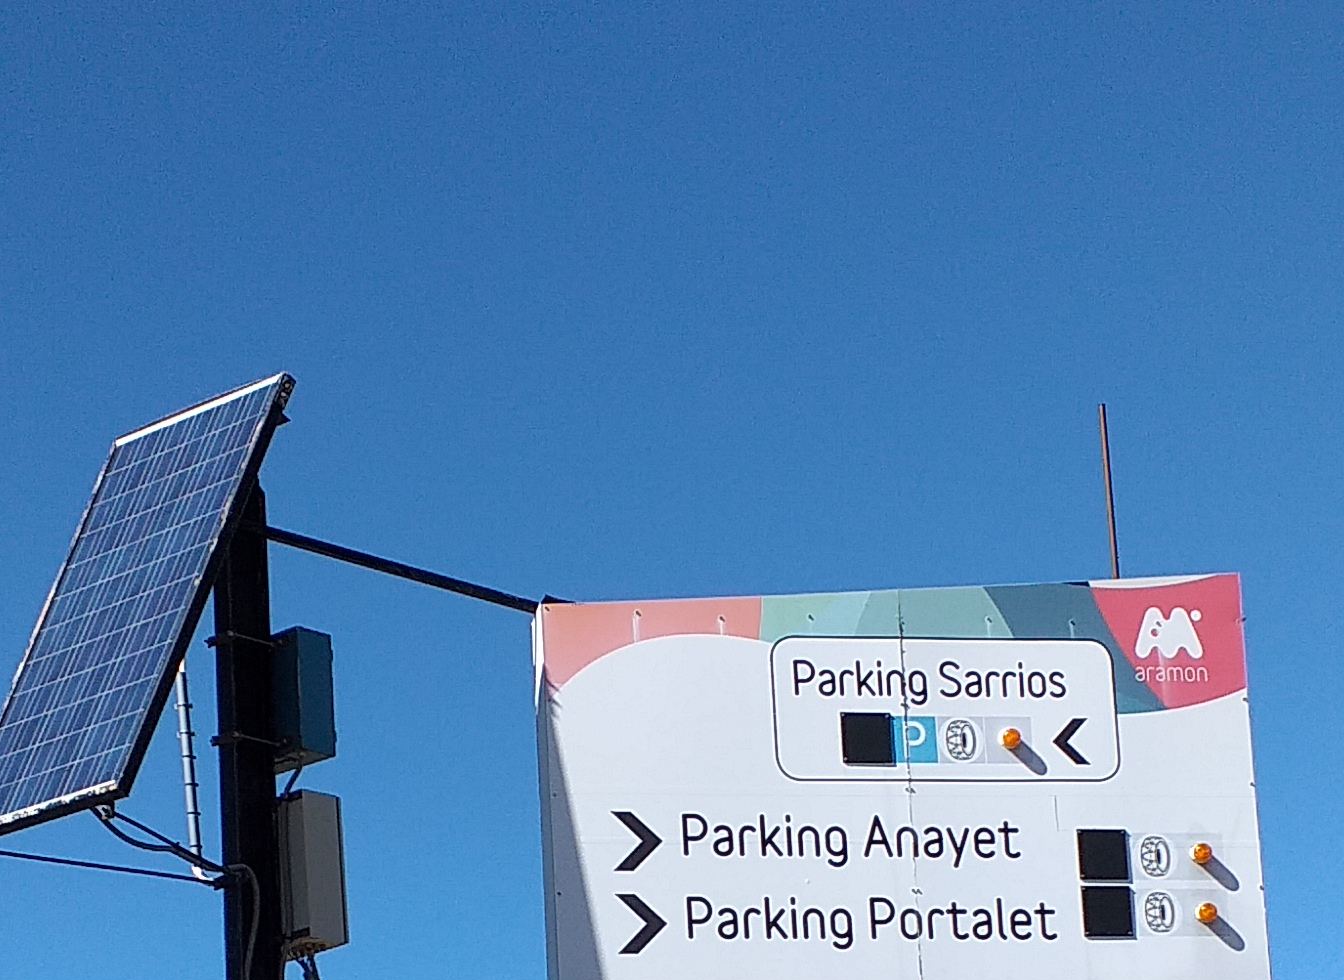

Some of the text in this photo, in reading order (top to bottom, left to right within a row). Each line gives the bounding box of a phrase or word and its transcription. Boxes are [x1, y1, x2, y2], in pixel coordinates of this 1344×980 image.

[792, 658, 1068, 706] Parking Sarrios
[1134, 665, 1208, 683] aramon
[680, 813, 1022, 869] Parking Anayet
[685, 896, 1058, 950] Parking Portalet
